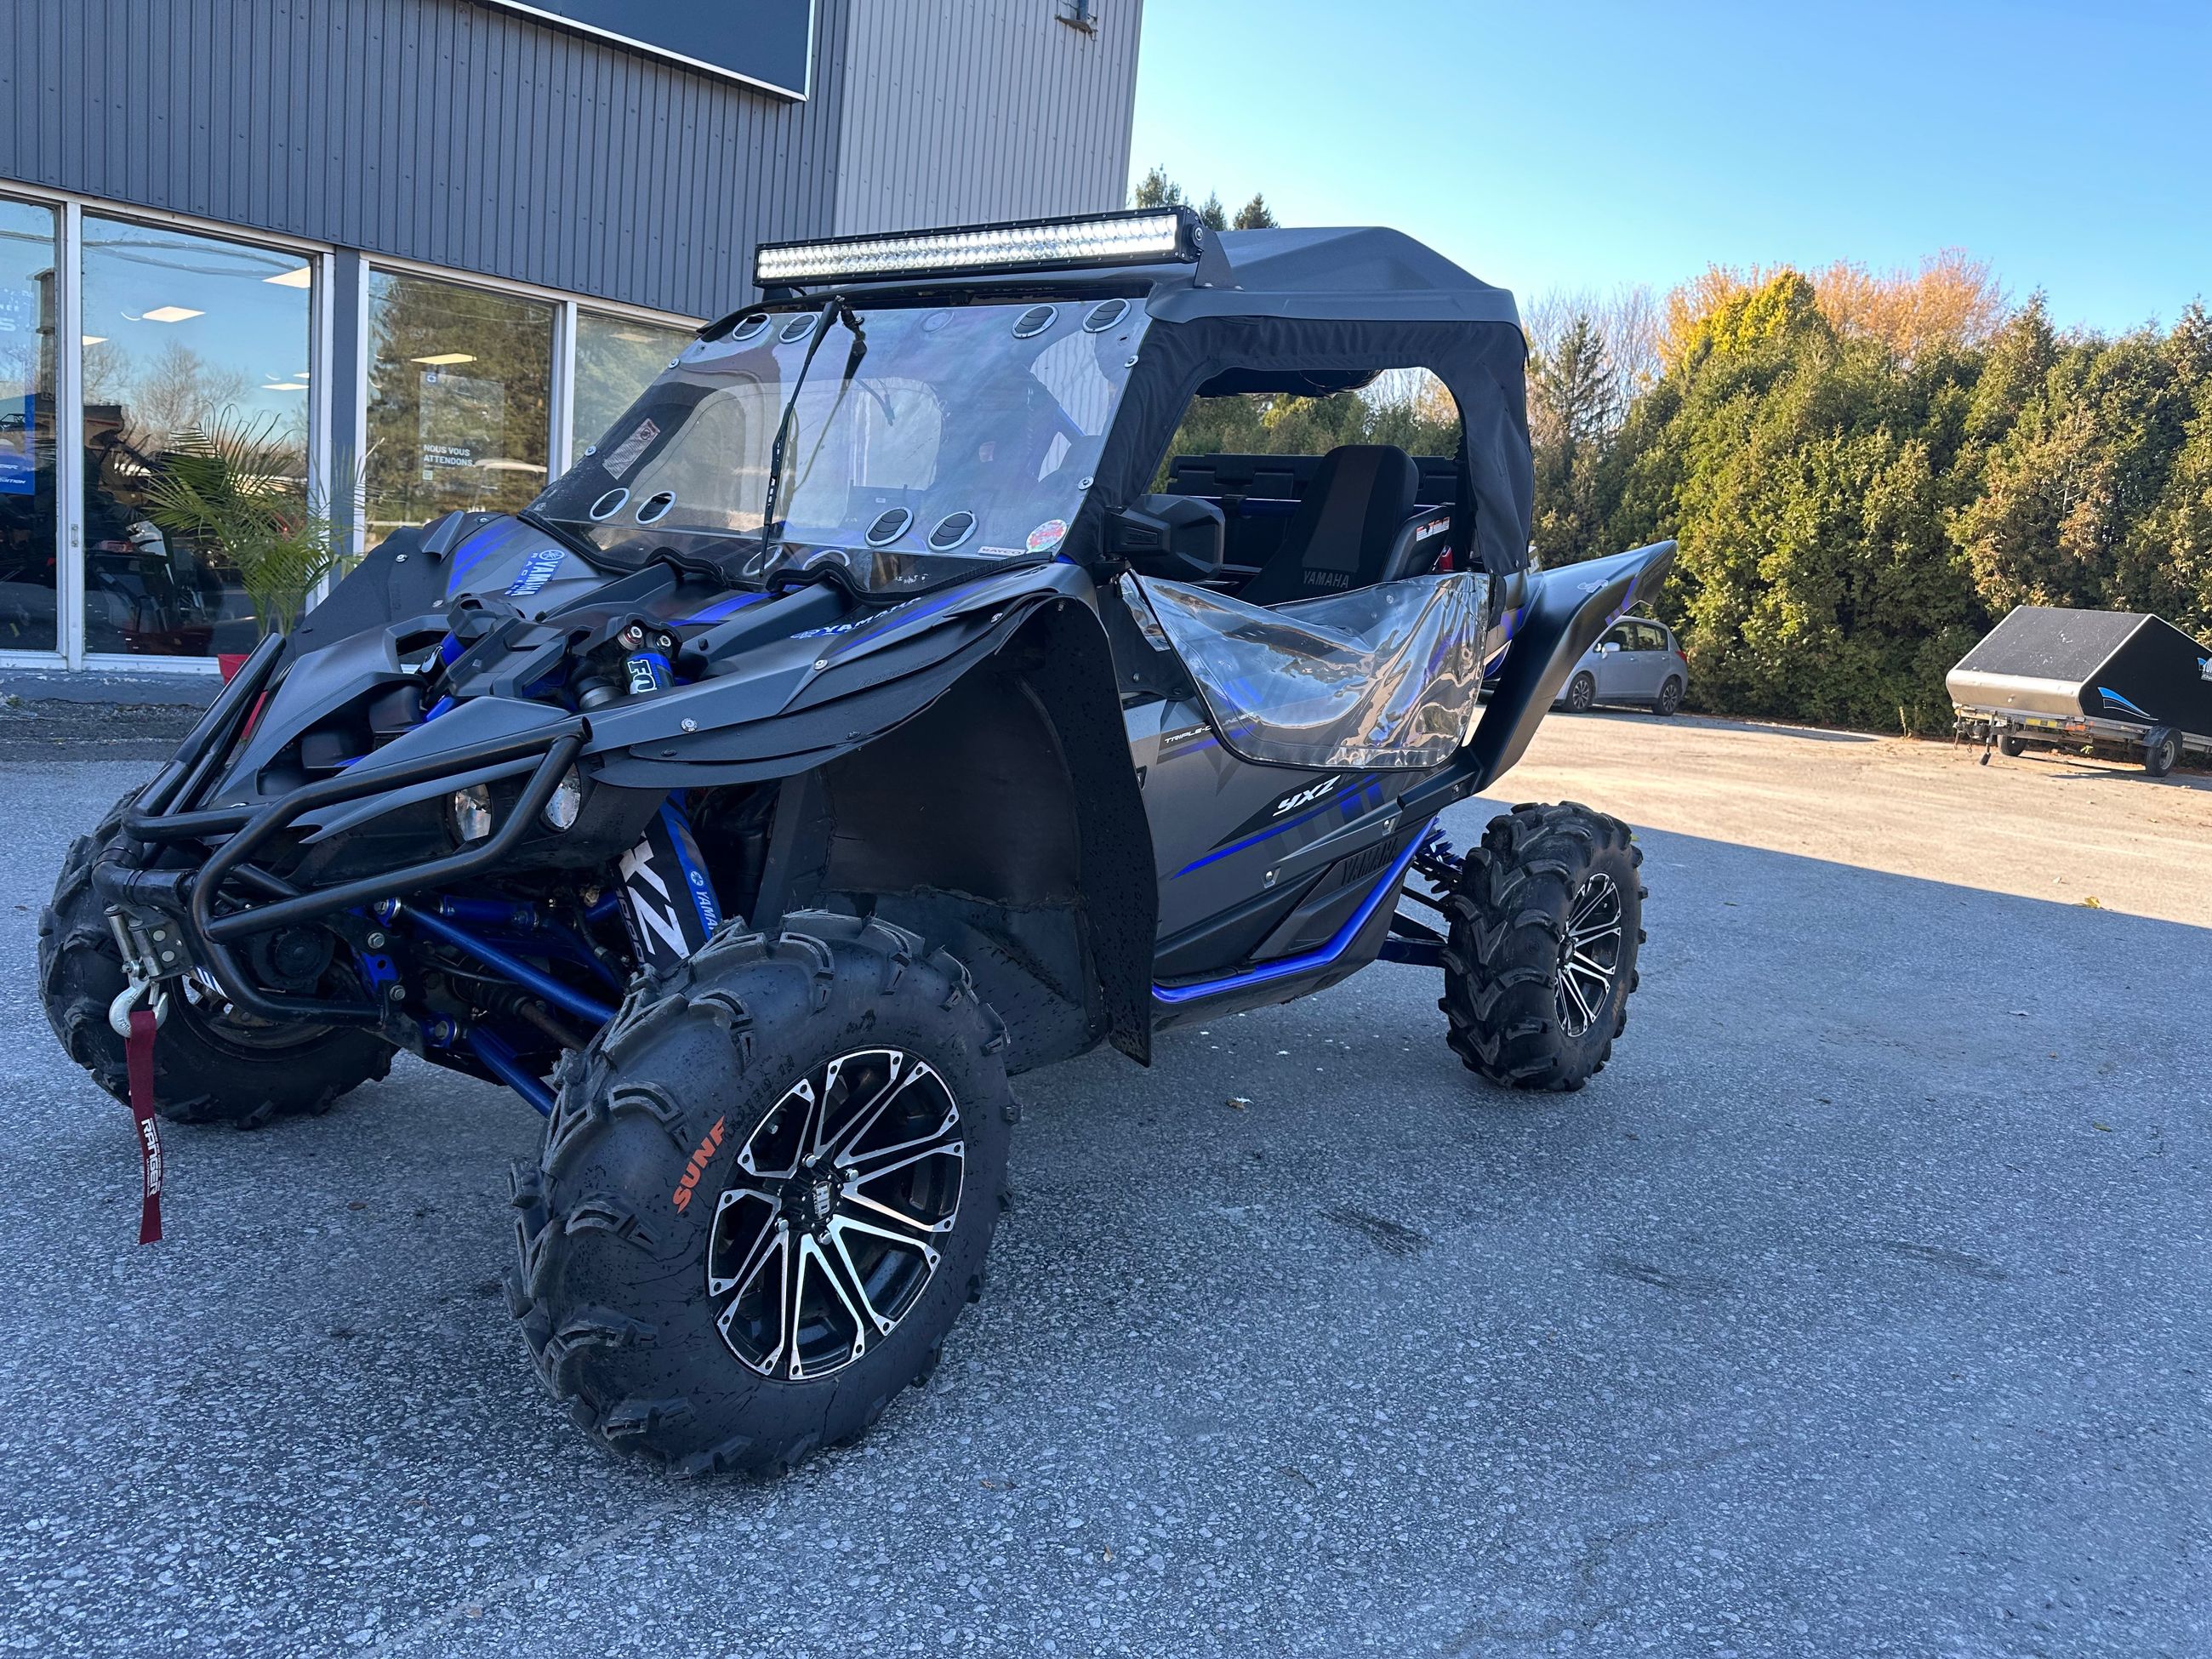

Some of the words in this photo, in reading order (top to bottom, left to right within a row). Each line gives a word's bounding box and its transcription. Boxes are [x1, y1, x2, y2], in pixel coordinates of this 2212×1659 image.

[424, 444, 448, 454] NOUS
[448, 447, 470, 457] VOUS
[510, 561, 559, 596] YAMAHA
[1303, 570, 1349, 589] YAMAHA
[1272, 774, 1342, 817] YXZ
[1341, 837, 1399, 887] YAMAHA
[696, 891, 719, 931] YAMA
[140, 1118, 159, 1197] RANGER
[672, 1115, 726, 1214] SUNF
